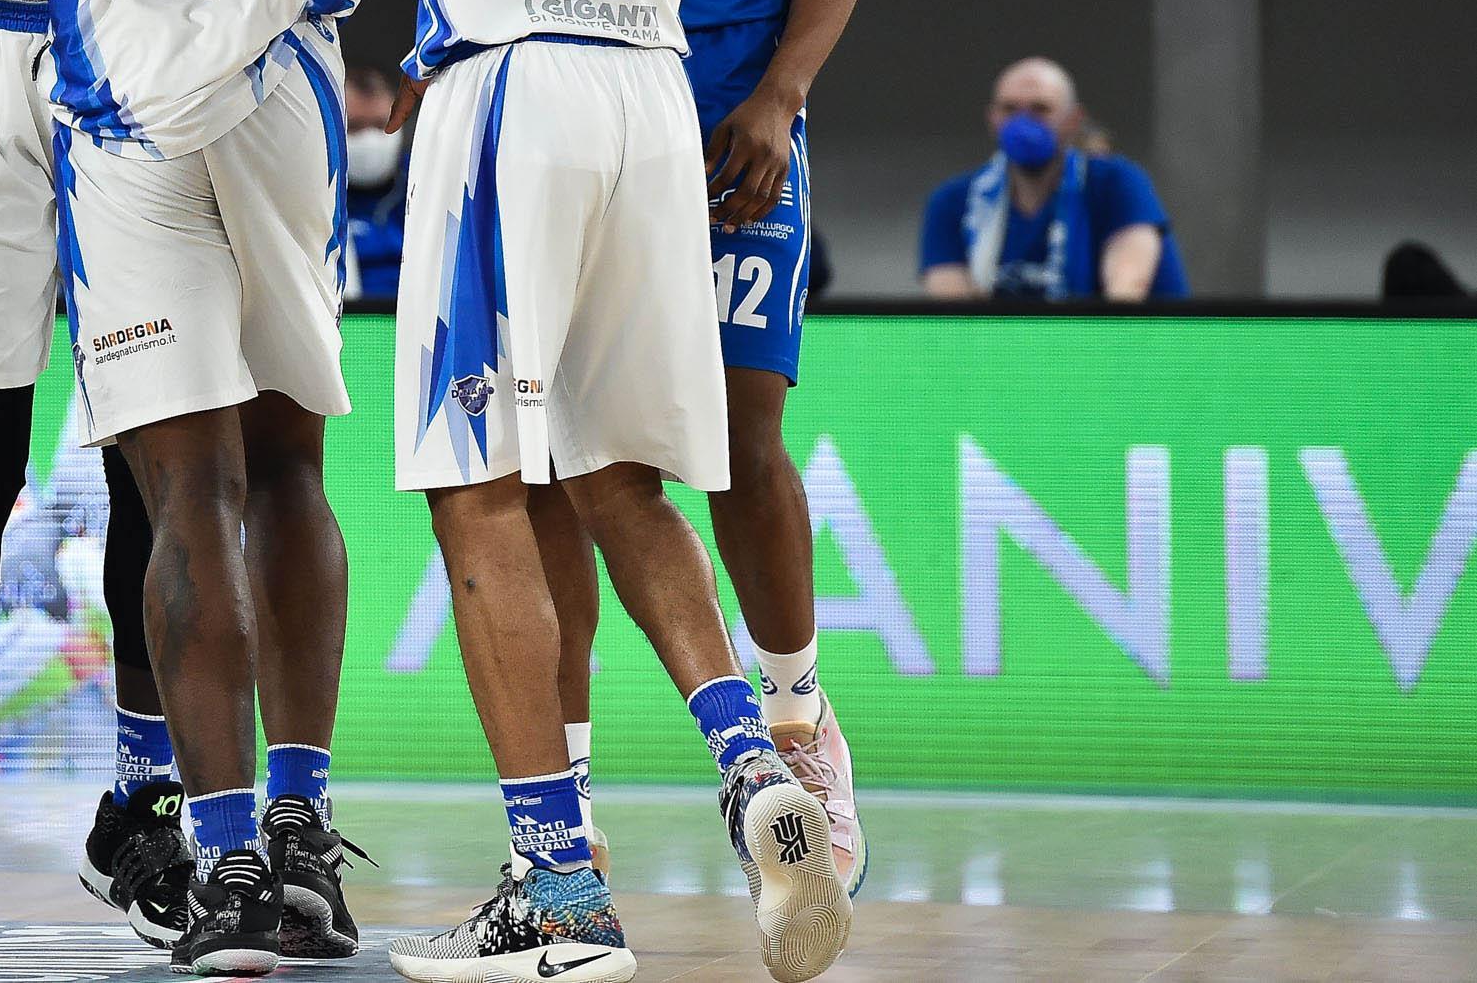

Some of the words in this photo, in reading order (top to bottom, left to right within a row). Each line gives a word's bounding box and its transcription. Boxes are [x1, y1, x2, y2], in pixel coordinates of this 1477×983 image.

[617, 28, 661, 42] RAMA
[760, 229, 788, 240] MARCO
[713, 253, 773, 330] 12
[93, 317, 173, 352] SARDEGNA
[95, 334, 177, 365] sardegnaturismo.it
[510, 820, 566, 836] NAMO
[513, 830, 571, 845] ASSARI
